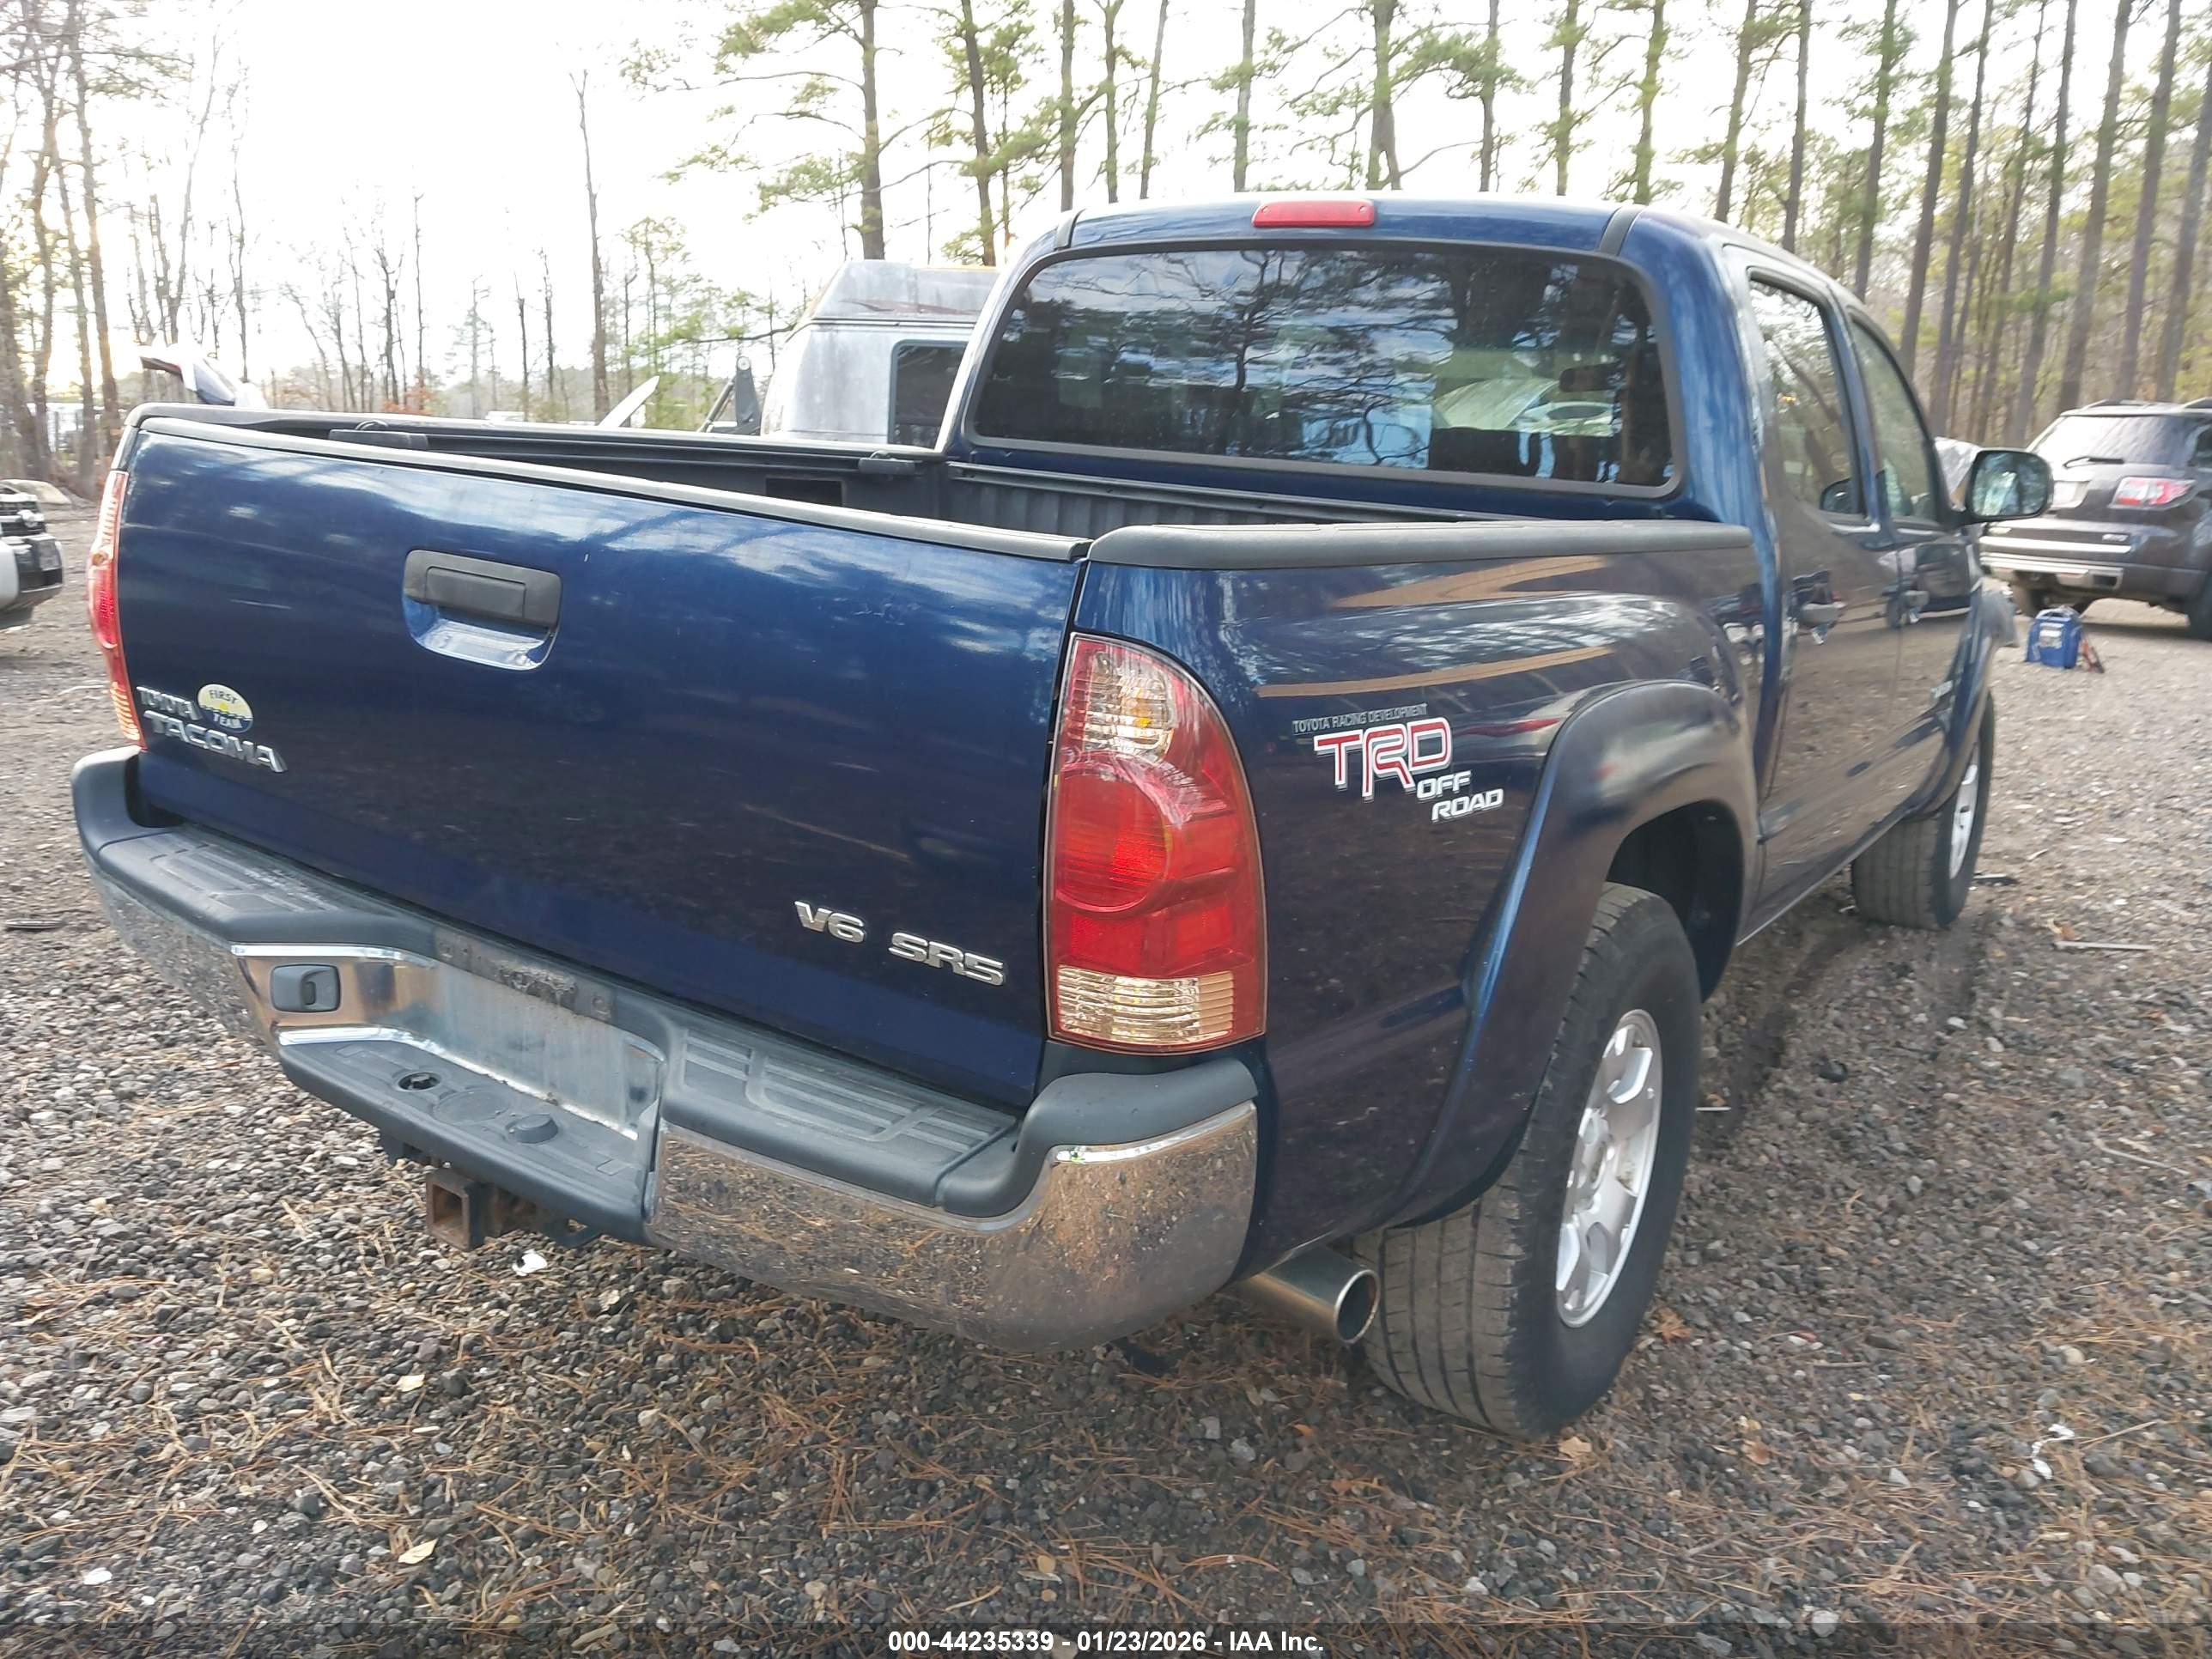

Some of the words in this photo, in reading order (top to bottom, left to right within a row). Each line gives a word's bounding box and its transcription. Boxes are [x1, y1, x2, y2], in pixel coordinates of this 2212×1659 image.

[136, 686, 203, 720] TOYOTA
[209, 689, 239, 704] FIRST
[1292, 718, 1330, 734] TOYOTA
[1332, 711, 1367, 728] RACING
[1368, 702, 1428, 723] DEVELOPMENT
[143, 710, 288, 773] TACOMA
[1314, 717, 1453, 799] TRD
[1417, 770, 1472, 800] OFF
[1431, 788, 1504, 822] ROAD
[794, 901, 866, 943] V6
[889, 932, 1005, 987] SR5
